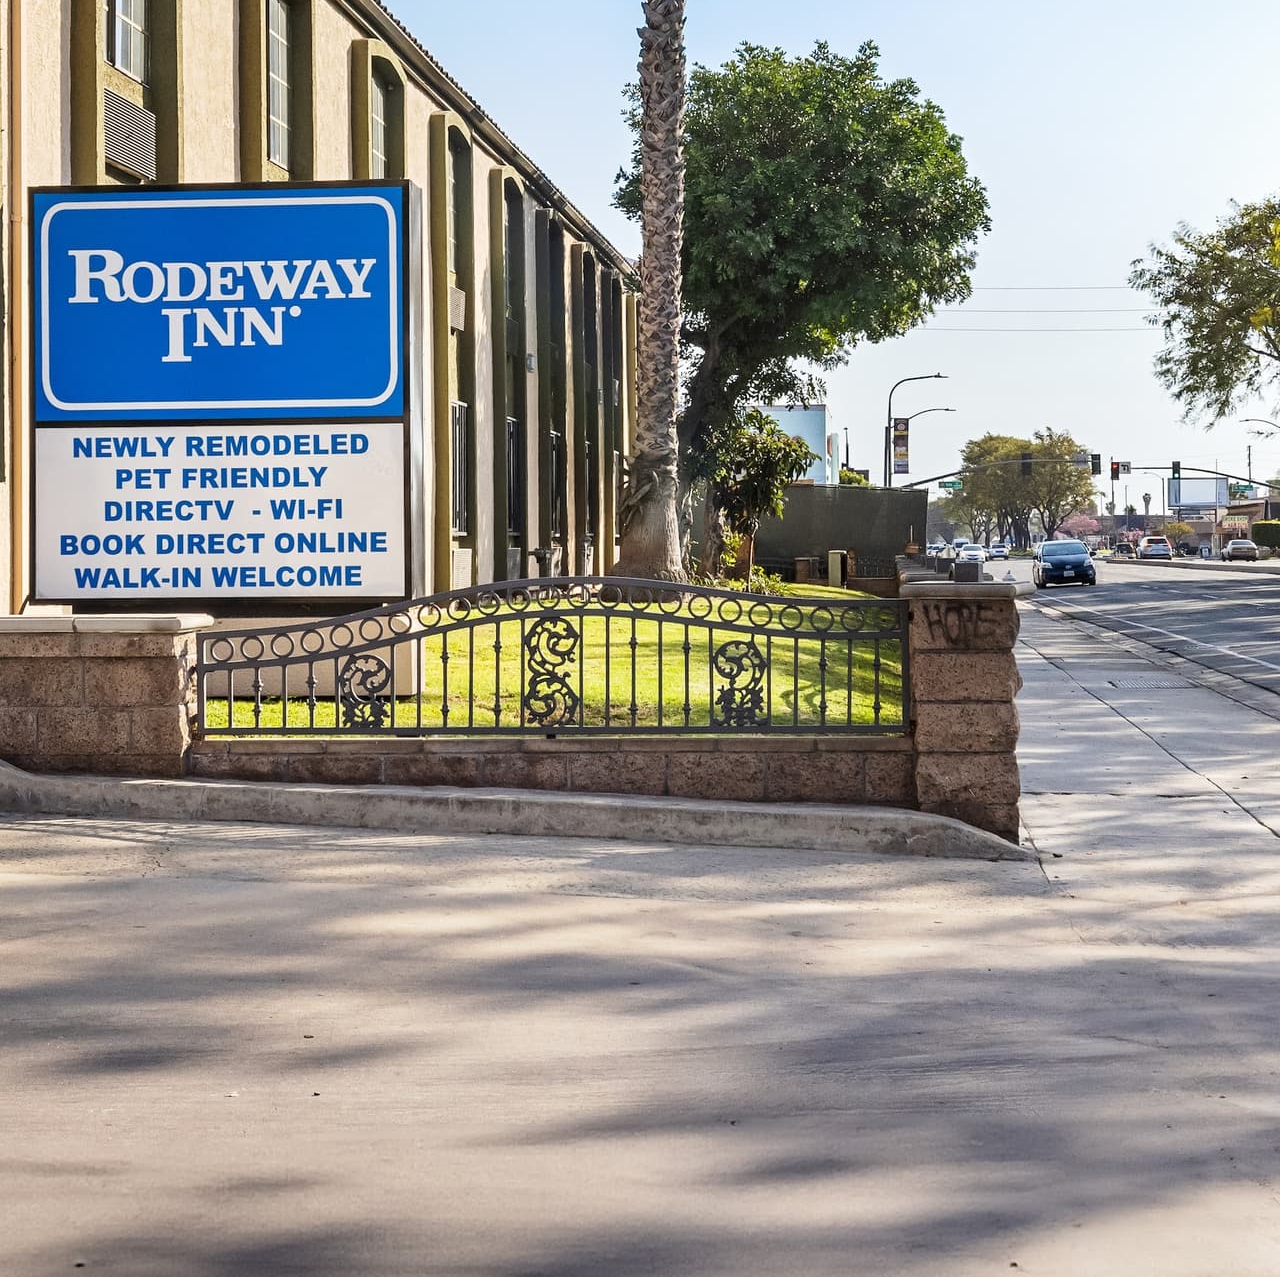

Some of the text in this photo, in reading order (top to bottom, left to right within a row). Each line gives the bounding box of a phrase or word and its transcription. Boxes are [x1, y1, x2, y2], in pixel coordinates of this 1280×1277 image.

[67, 249, 377, 304] RODEWAY
[161, 306, 286, 363] INN
[72, 434, 369, 458] NEWLY REMODELED
[116, 466, 328, 489] PET FRIENDLY
[104, 500, 235, 522] DIRECTV
[270, 498, 343, 520] WI-FI
[60, 531, 388, 556] BOOK DIRECT ONLINE
[74, 565, 362, 588] WALK-IN WELCOME
